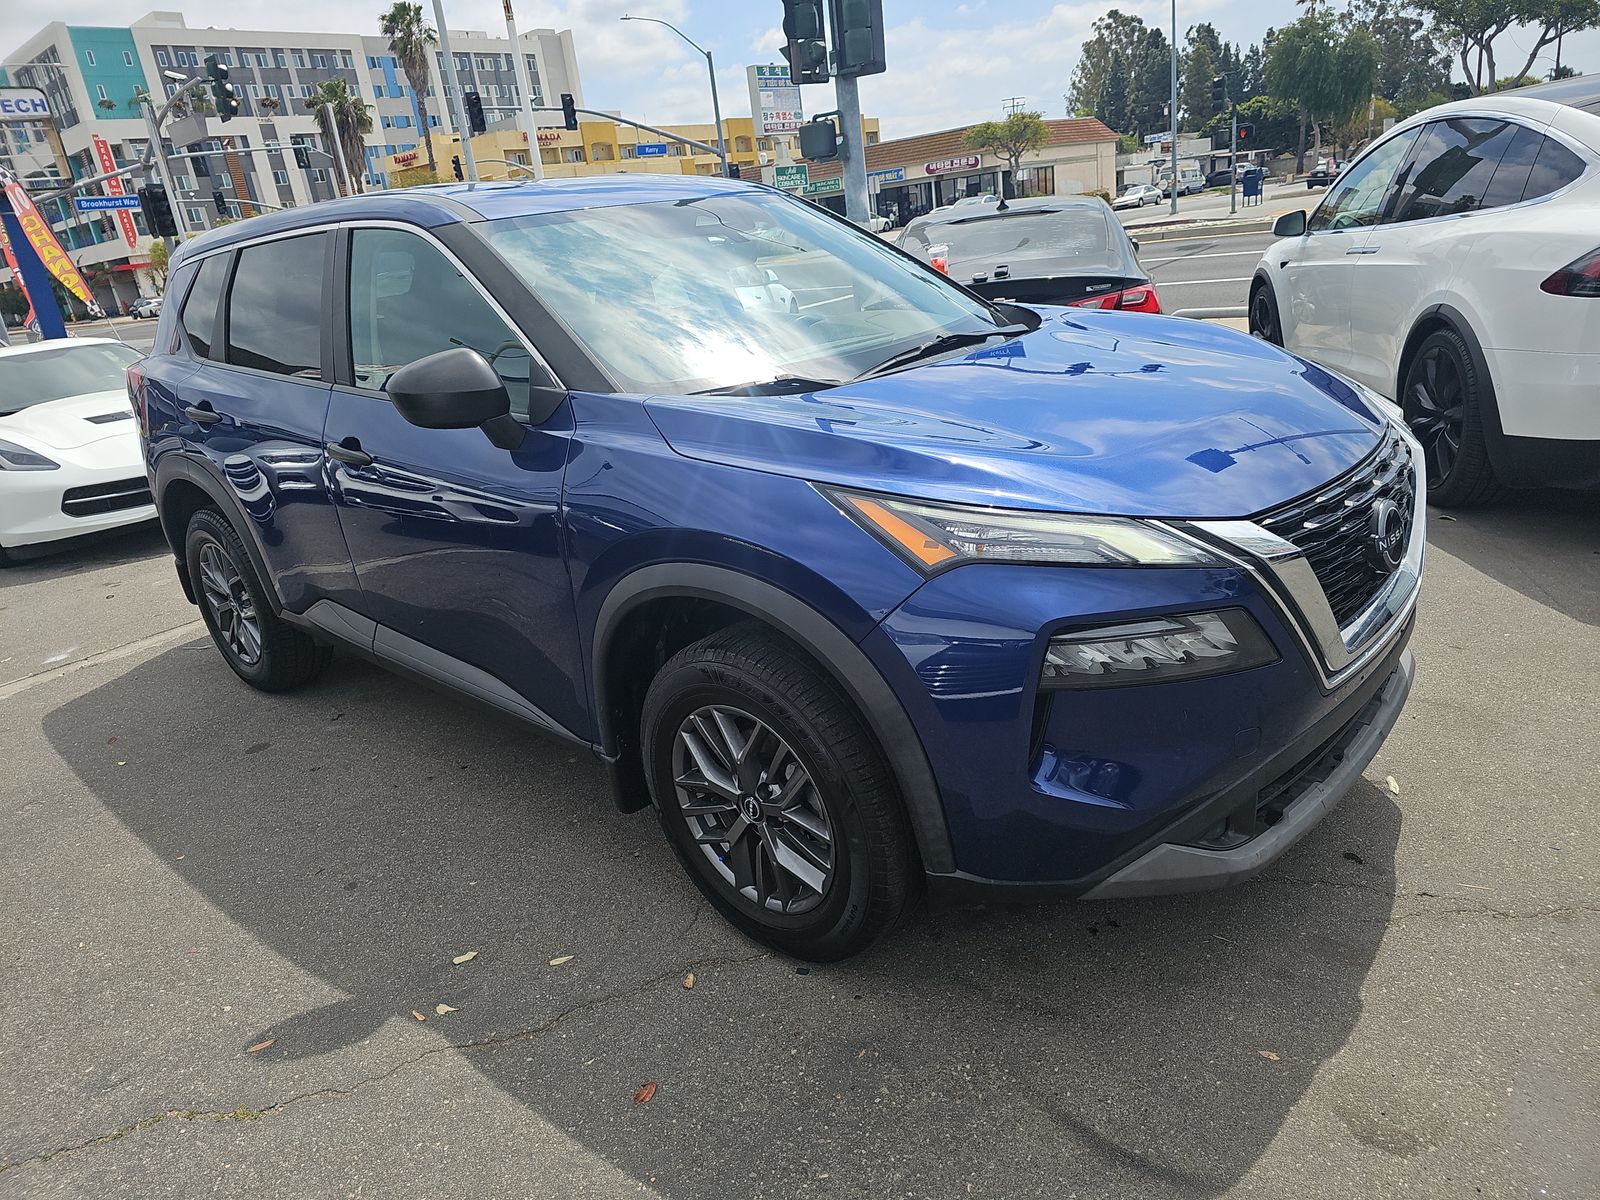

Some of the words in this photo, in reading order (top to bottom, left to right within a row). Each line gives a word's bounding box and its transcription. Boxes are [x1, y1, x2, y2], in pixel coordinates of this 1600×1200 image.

[523, 131, 562, 142] RMADA
[98, 141, 117, 186] LEASIG
[81, 199, 123, 208] Brookhurst
[122, 198, 139, 207] Way
